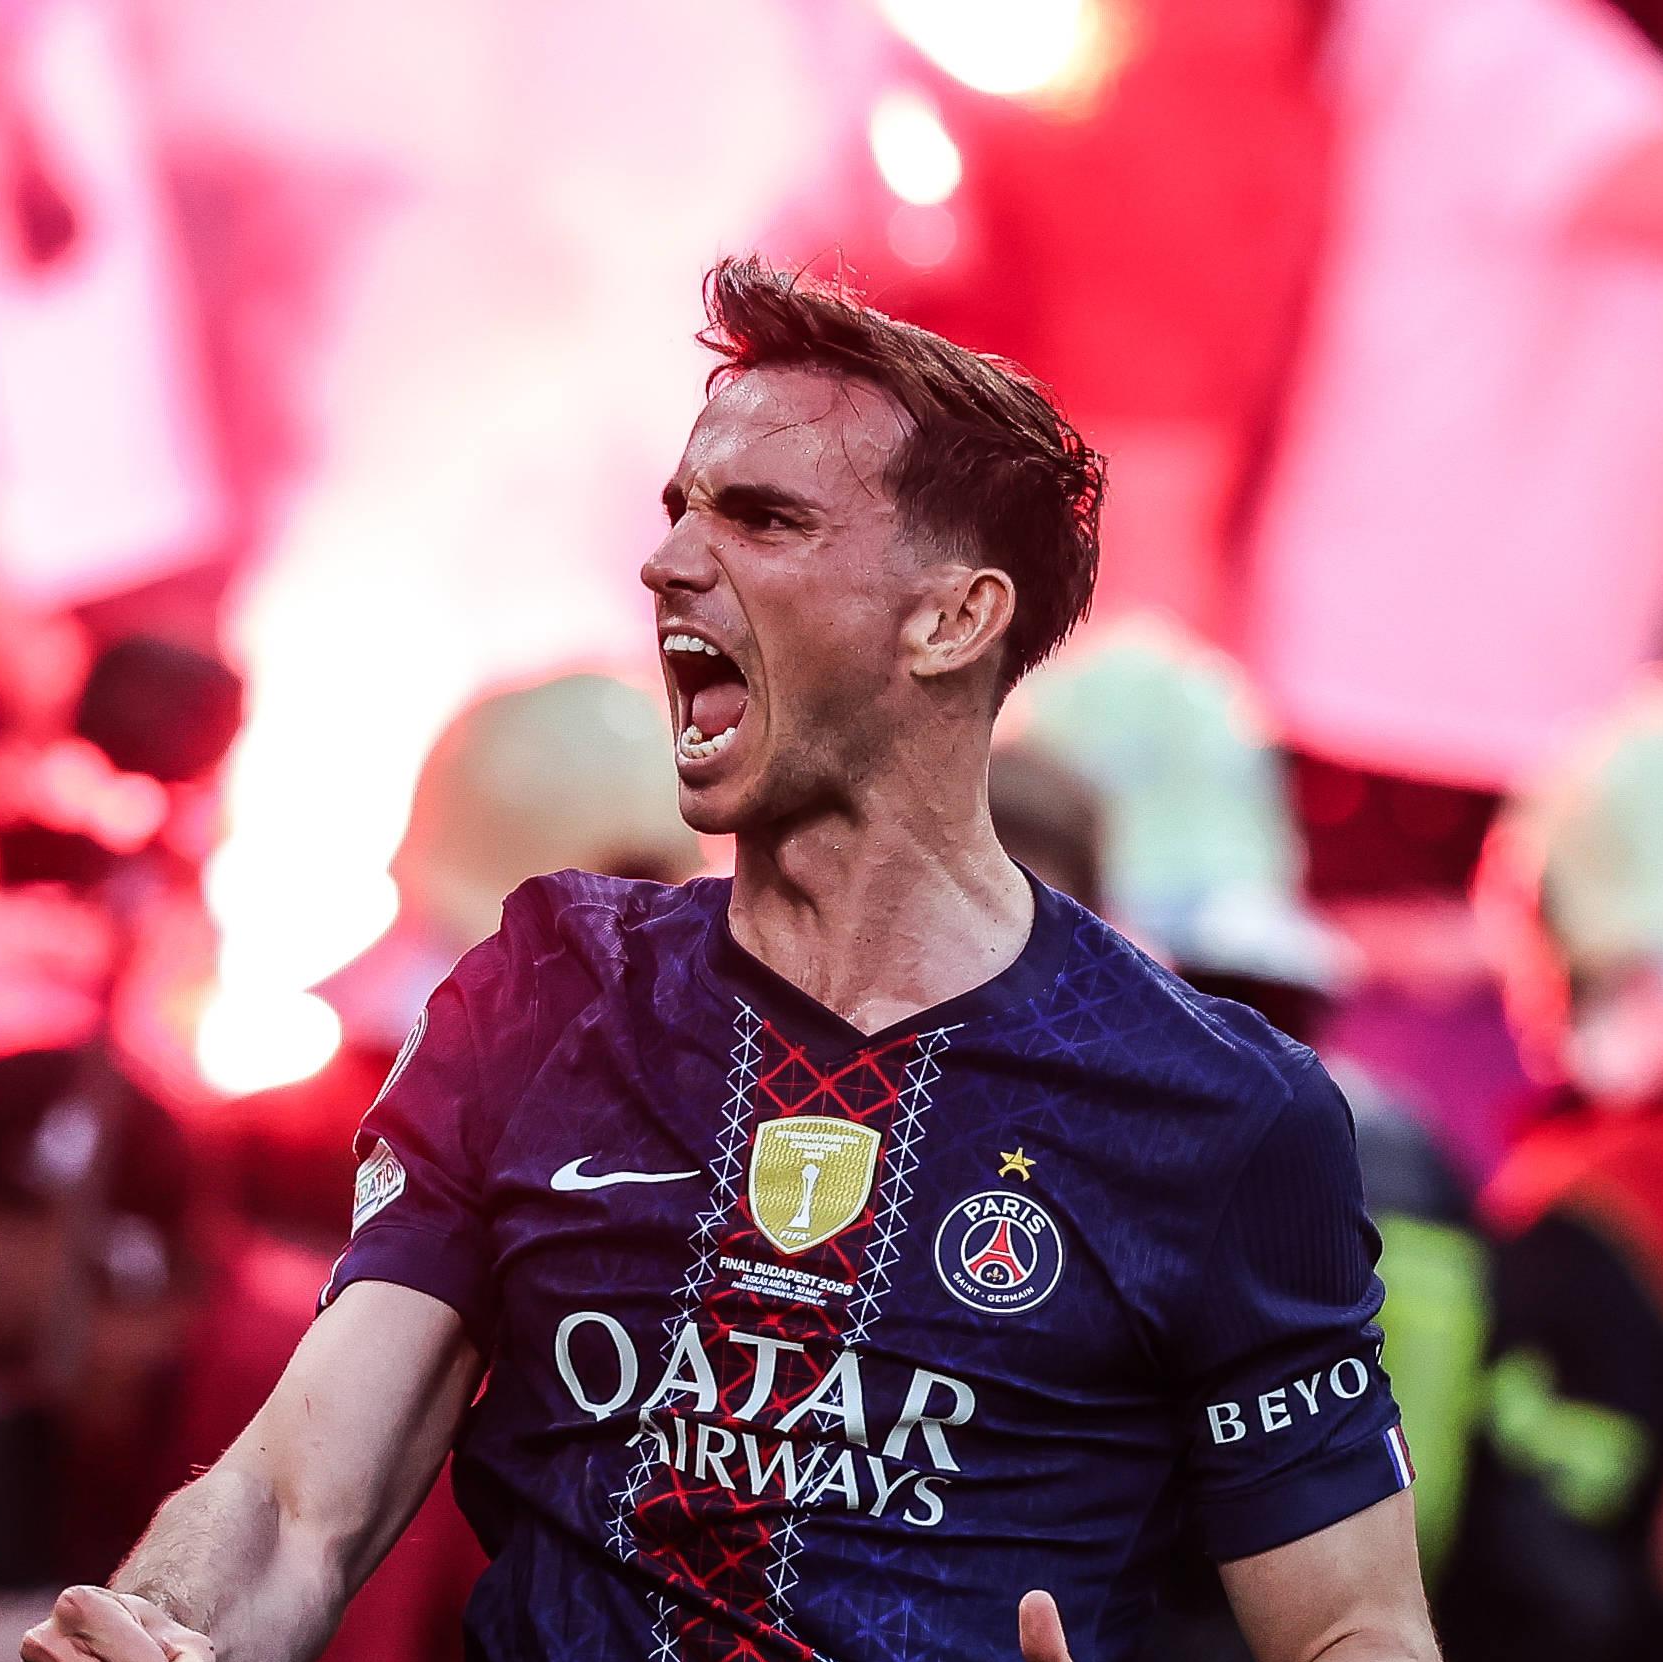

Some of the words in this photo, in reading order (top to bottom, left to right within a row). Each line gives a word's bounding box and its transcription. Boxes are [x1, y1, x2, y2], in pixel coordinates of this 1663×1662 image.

[779, 1230, 810, 1241] FIFA
[962, 1197, 1047, 1235] PARIS
[719, 1256, 753, 1273] FINAL
[754, 1262, 819, 1287] BUDAPEST
[818, 1278, 853, 1296] 2026
[795, 1284, 806, 1294] 30
[805, 1287, 823, 1298] MAY
[952, 1271, 980, 1297] SAINT
[987, 1286, 1035, 1303] GERMAIN
[555, 1311, 976, 1473] QATAR
[1206, 1343, 1382, 1445] BEYO
[625, 1407, 954, 1528] AIRWAYS
